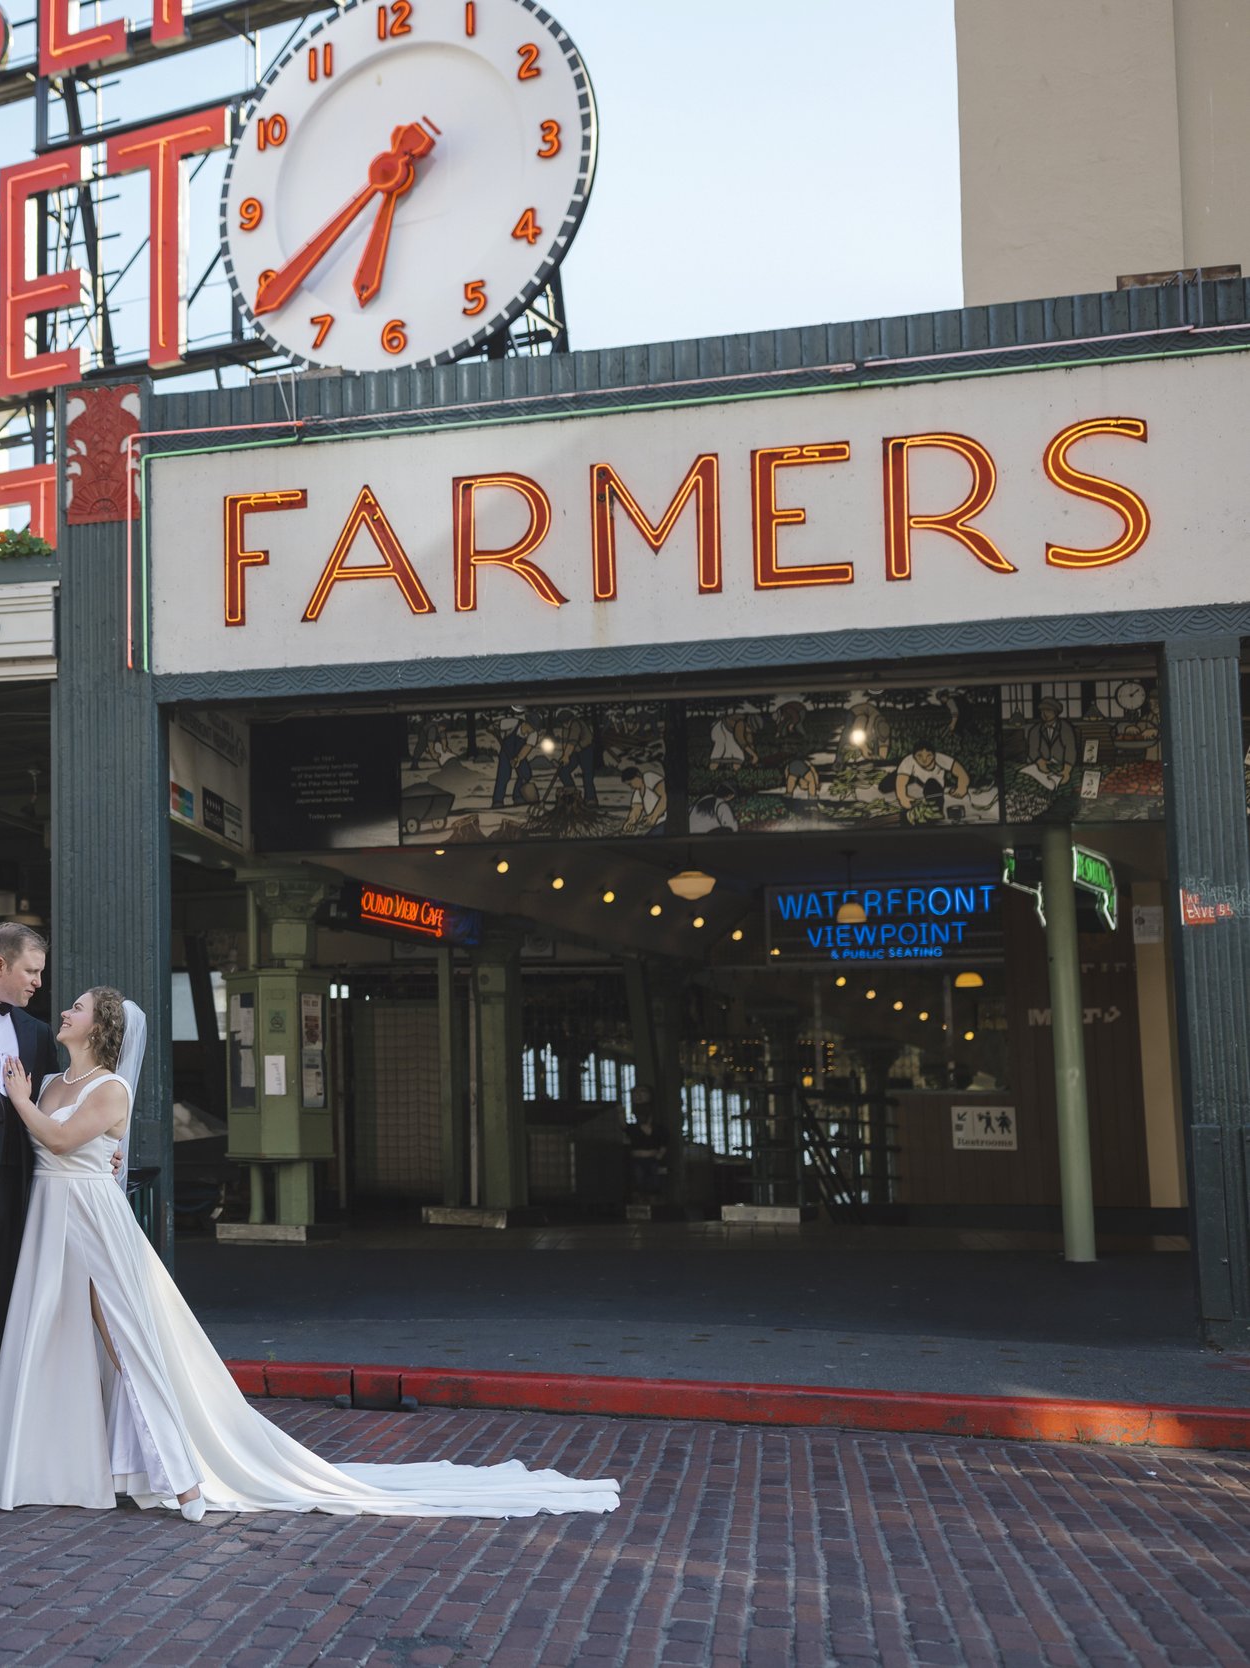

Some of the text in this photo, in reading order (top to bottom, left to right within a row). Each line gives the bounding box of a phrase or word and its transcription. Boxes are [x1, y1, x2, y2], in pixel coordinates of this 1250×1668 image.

[377, 0, 412, 40] 12
[464, 0, 476, 37] 1
[308, 42, 334, 82] 11
[517, 42, 542, 82] 2
[257, 113, 288, 152] 10
[537, 119, 561, 159] 3
[239, 197, 263, 232] 9
[511, 207, 542, 245] 4
[463, 279, 488, 318] 5
[310, 313, 335, 350] 7
[381, 318, 408, 355] 6
[223, 416, 1151, 628] FARMERS
[361, 887, 394, 916] OUND
[806, 921, 968, 948] VIEWPOINT
[842, 947, 885, 960] PUBLIC
[888, 946, 944, 959] SEATING
